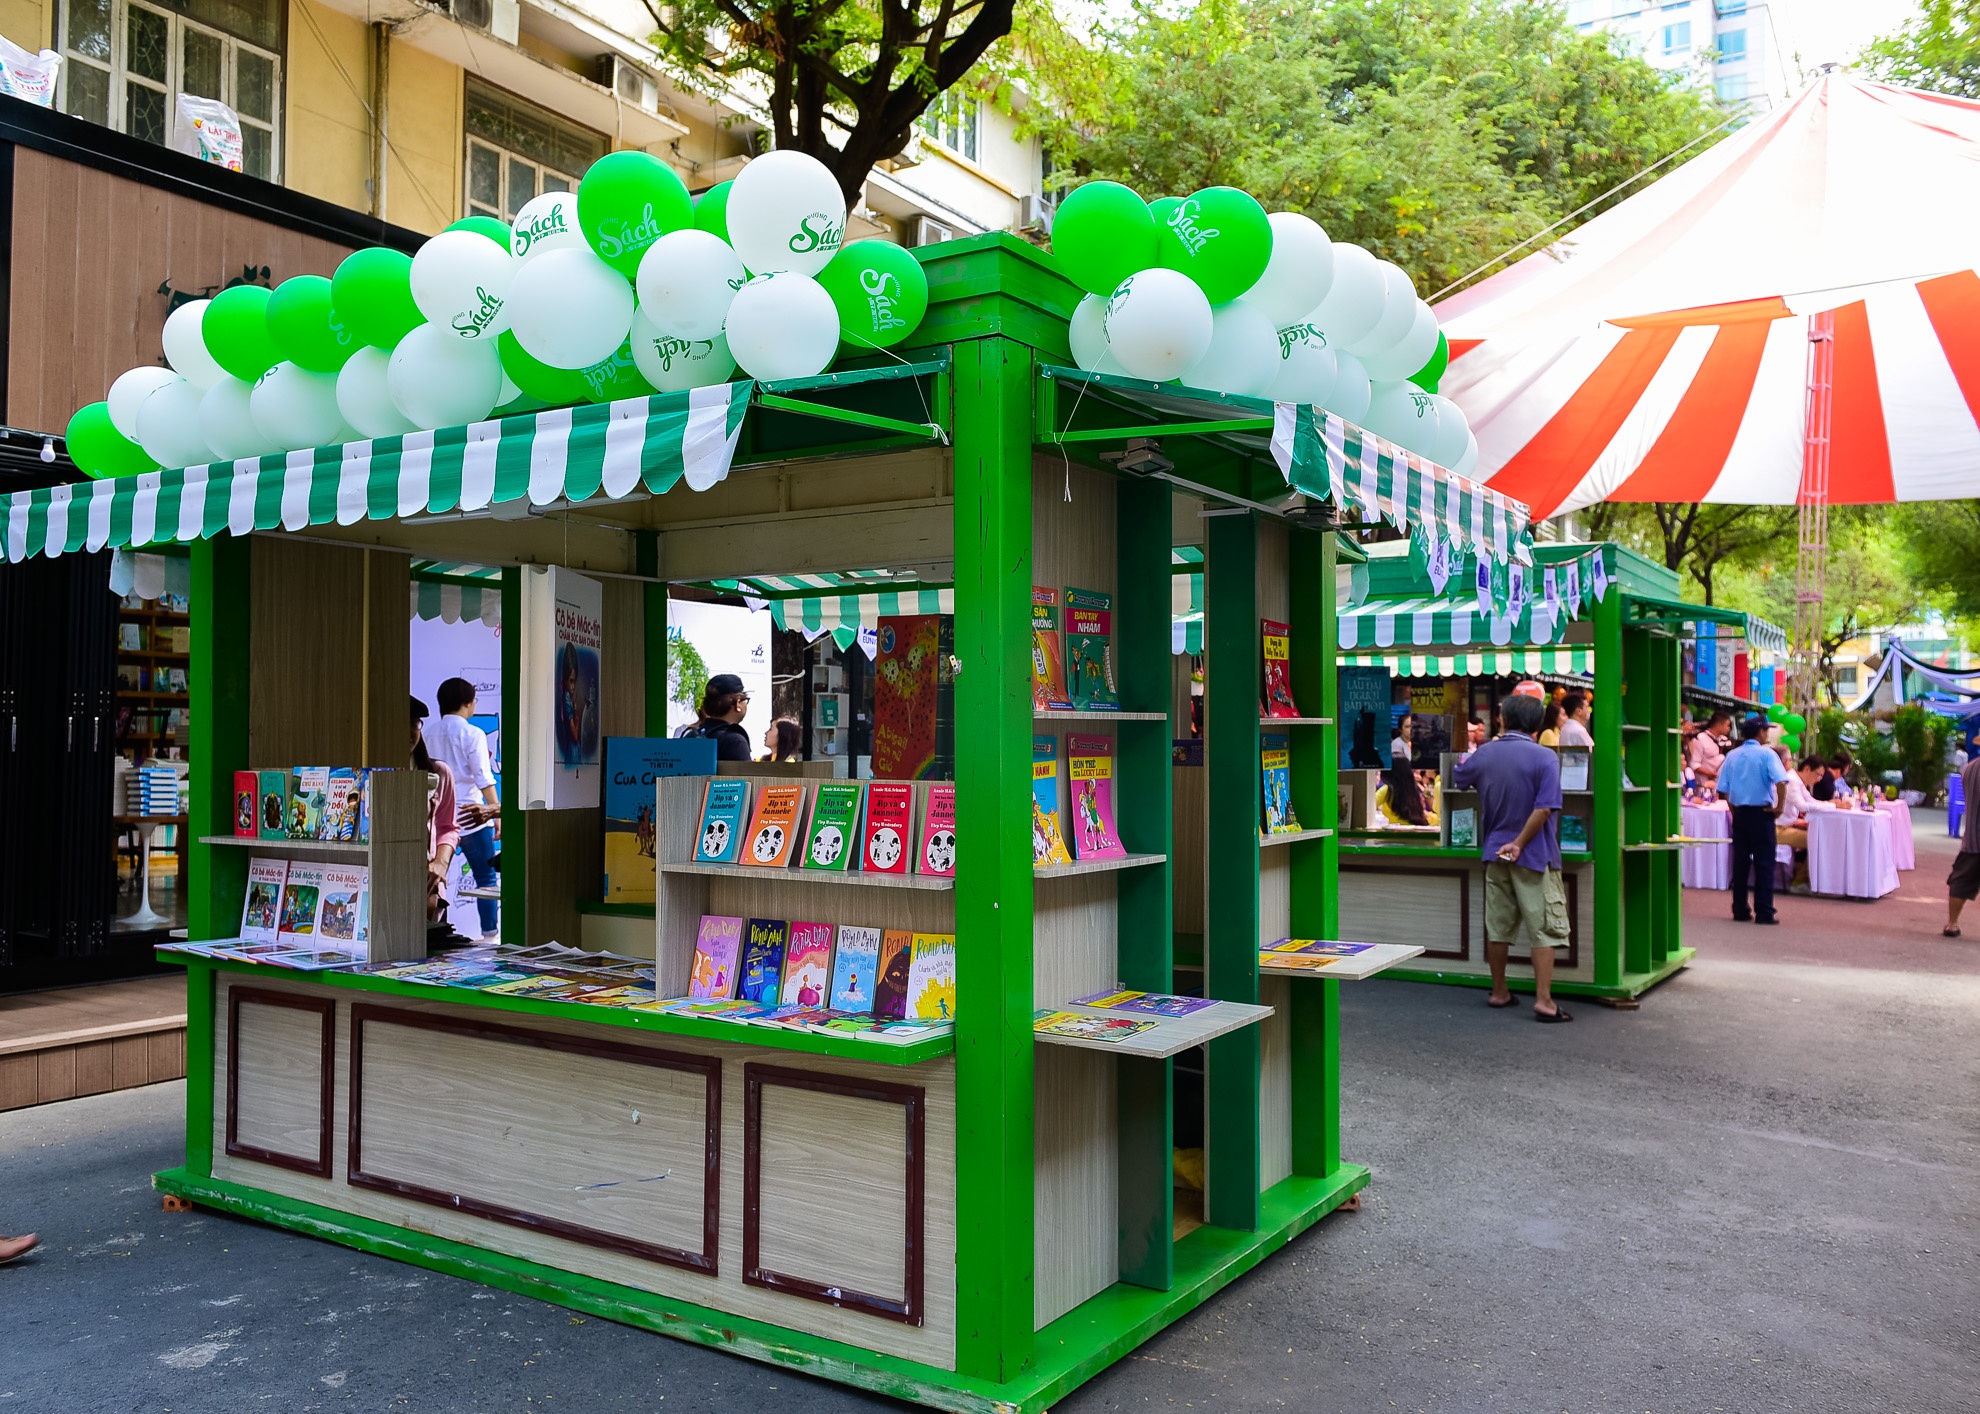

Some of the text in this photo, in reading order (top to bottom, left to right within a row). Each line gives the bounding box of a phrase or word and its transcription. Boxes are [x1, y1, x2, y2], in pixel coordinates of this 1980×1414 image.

[515, 203, 568, 258] Sách
[597, 202, 663, 258] Sách
[1167, 200, 1220, 253] Sách
[860, 268, 906, 332] Sách
[451, 286, 500, 340] Sách
[1279, 323, 1327, 361] Sách
[1050, 592, 1054, 604] 1
[1104, 599, 1110, 609] 2
[555, 608, 565, 628] Cô
[567, 609, 576, 630] bé
[1088, 612, 1098, 620] TAY
[1411, 686, 1443, 697] vespa
[878, 723, 908, 750] Abigail
[1046, 743, 1051, 753] 3
[1103, 743, 1108, 751] 4
[1080, 769, 1096, 777] LUCKY
[1096, 768, 1108, 776] LUKE
[614, 772, 637, 785] CUA
[333, 790, 346, 799] NÓI
[714, 794, 732, 803] Jip và
[331, 799, 344, 810] DỐI
[710, 802, 736, 810] Janneke
[768, 800, 779, 809] Jip
[824, 799, 835, 808] Jip
[876, 800, 898, 809] Jip và
[936, 801, 948, 811] Jip
[819, 807, 849, 815] Janneke
[872, 808, 903, 817] Janneke
[931, 810, 955, 818] Janne
[252, 868, 258, 876] Cô
[258, 868, 265, 876] bé
[294, 870, 302, 878] bé
[327, 873, 335, 882] Cô
[336, 874, 343, 882] bé
[701, 920, 741, 942] ROALD DAHL
[751, 924, 784, 948] ROALD DAHL
[790, 925, 831, 955] ROALD DAHL
[842, 929, 878, 951] ROALD DAHL
[916, 938, 940, 960] ROALD
